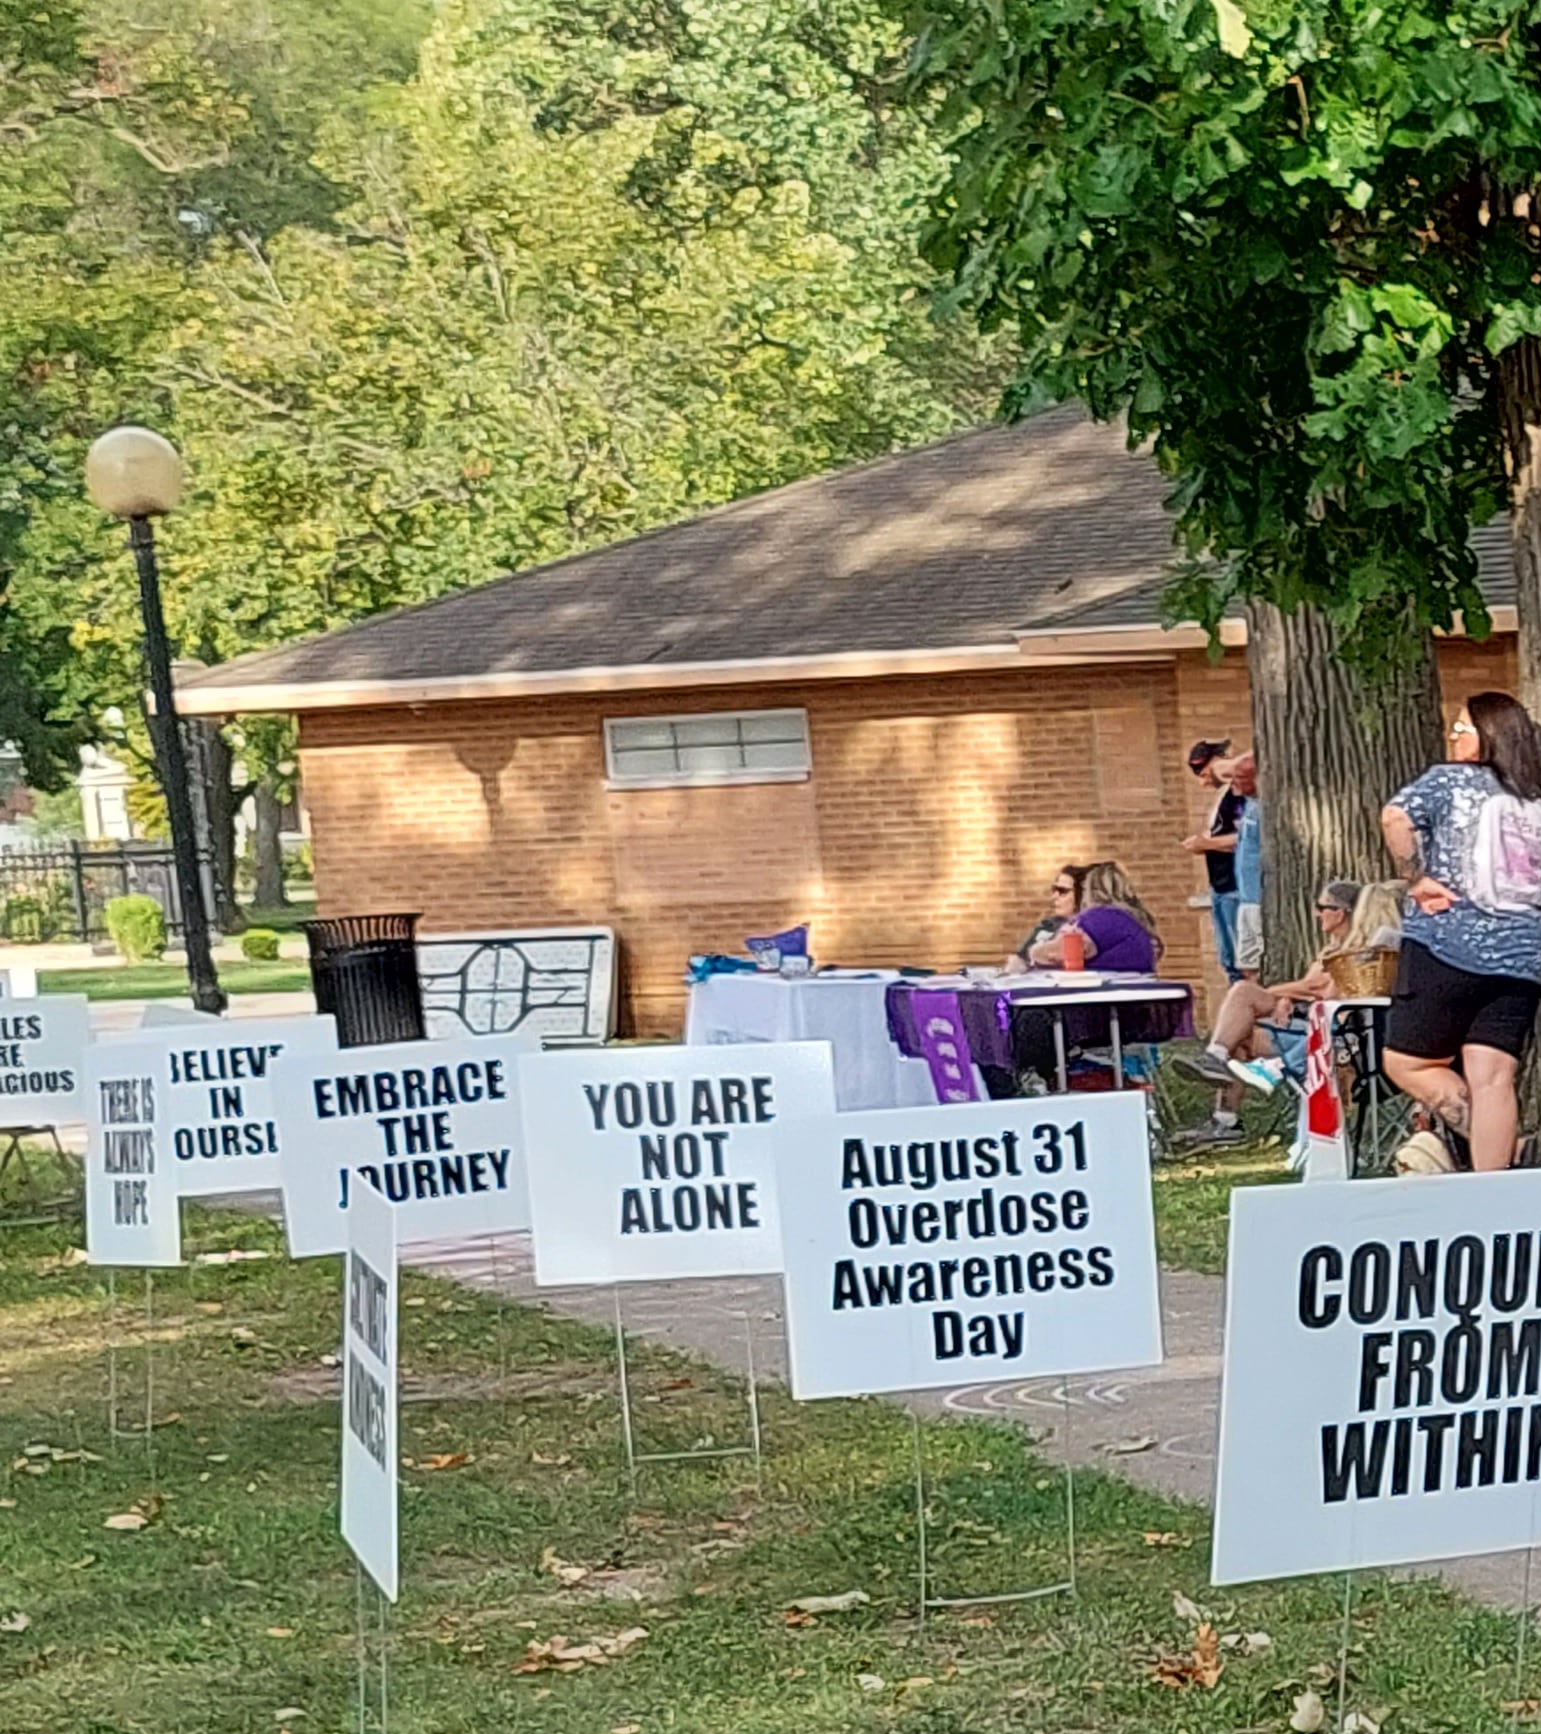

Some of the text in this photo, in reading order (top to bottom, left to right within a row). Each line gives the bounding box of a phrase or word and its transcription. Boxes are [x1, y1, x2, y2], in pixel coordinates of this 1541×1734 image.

[209, 1085, 243, 1119] IN
[313, 1059, 506, 1120] EMBRACE
[582, 1076, 776, 1130] YOU ARE
[376, 1111, 454, 1157] THE
[640, 1131, 730, 1181] NOT
[841, 1121, 1088, 1190] August 31
[620, 1182, 761, 1235] ALONE
[848, 1187, 1090, 1249] Overdose
[832, 1245, 1115, 1311] Awareness
[932, 1310, 1025, 1360] Day
